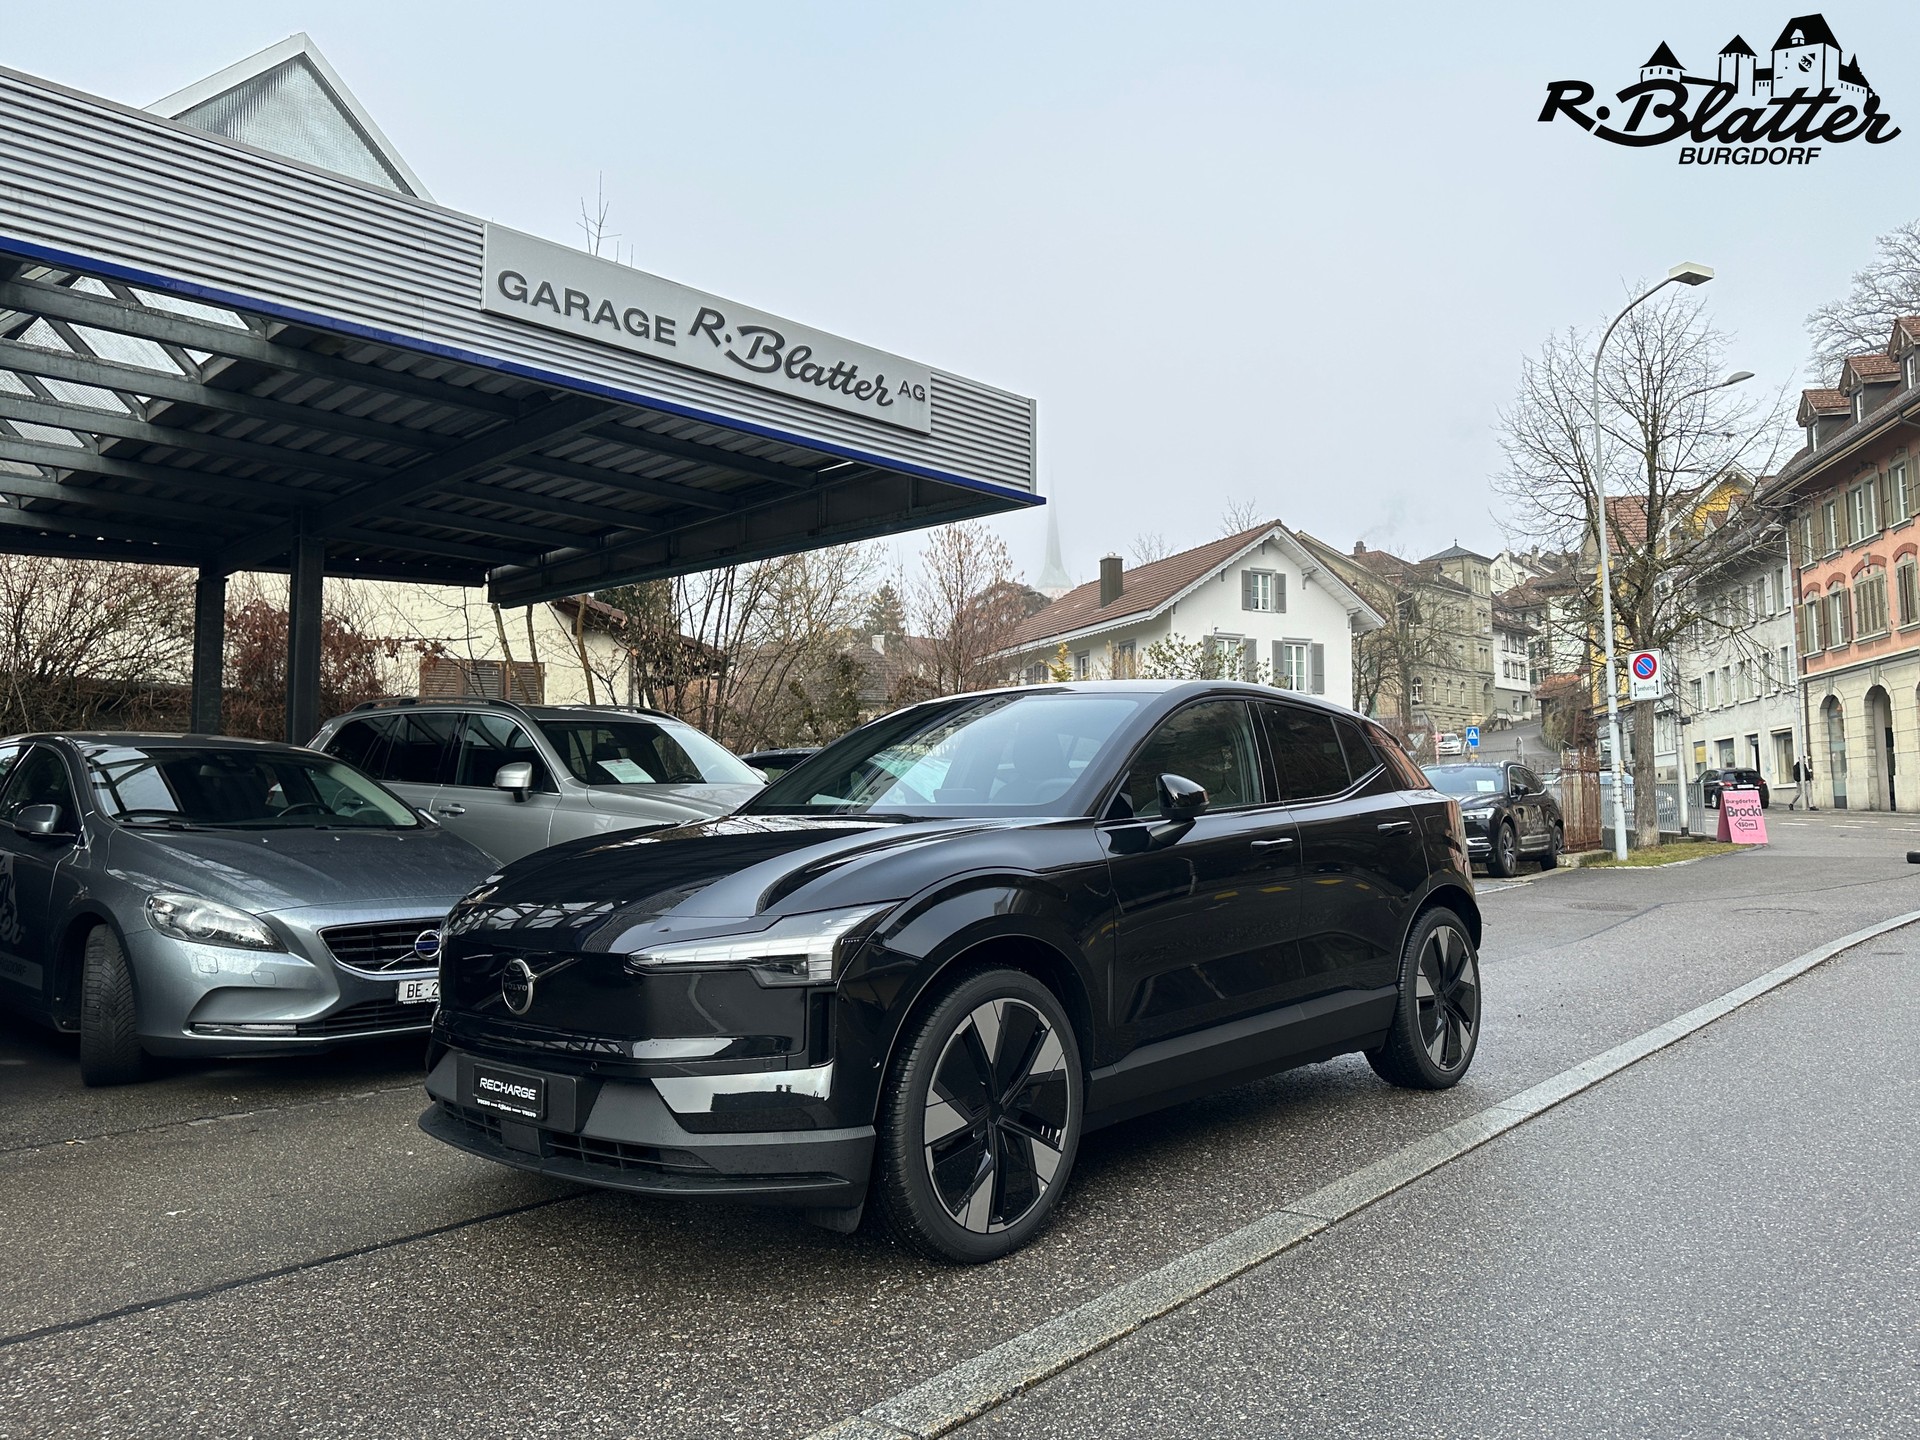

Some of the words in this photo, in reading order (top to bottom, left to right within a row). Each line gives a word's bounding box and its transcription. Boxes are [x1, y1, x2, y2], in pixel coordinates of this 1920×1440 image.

[498, 269, 677, 348] GARAGE
[897, 381, 926, 403] AG
[1727, 805, 1762, 817] Brocki
[480, 1077, 537, 1101] RECHARGE
